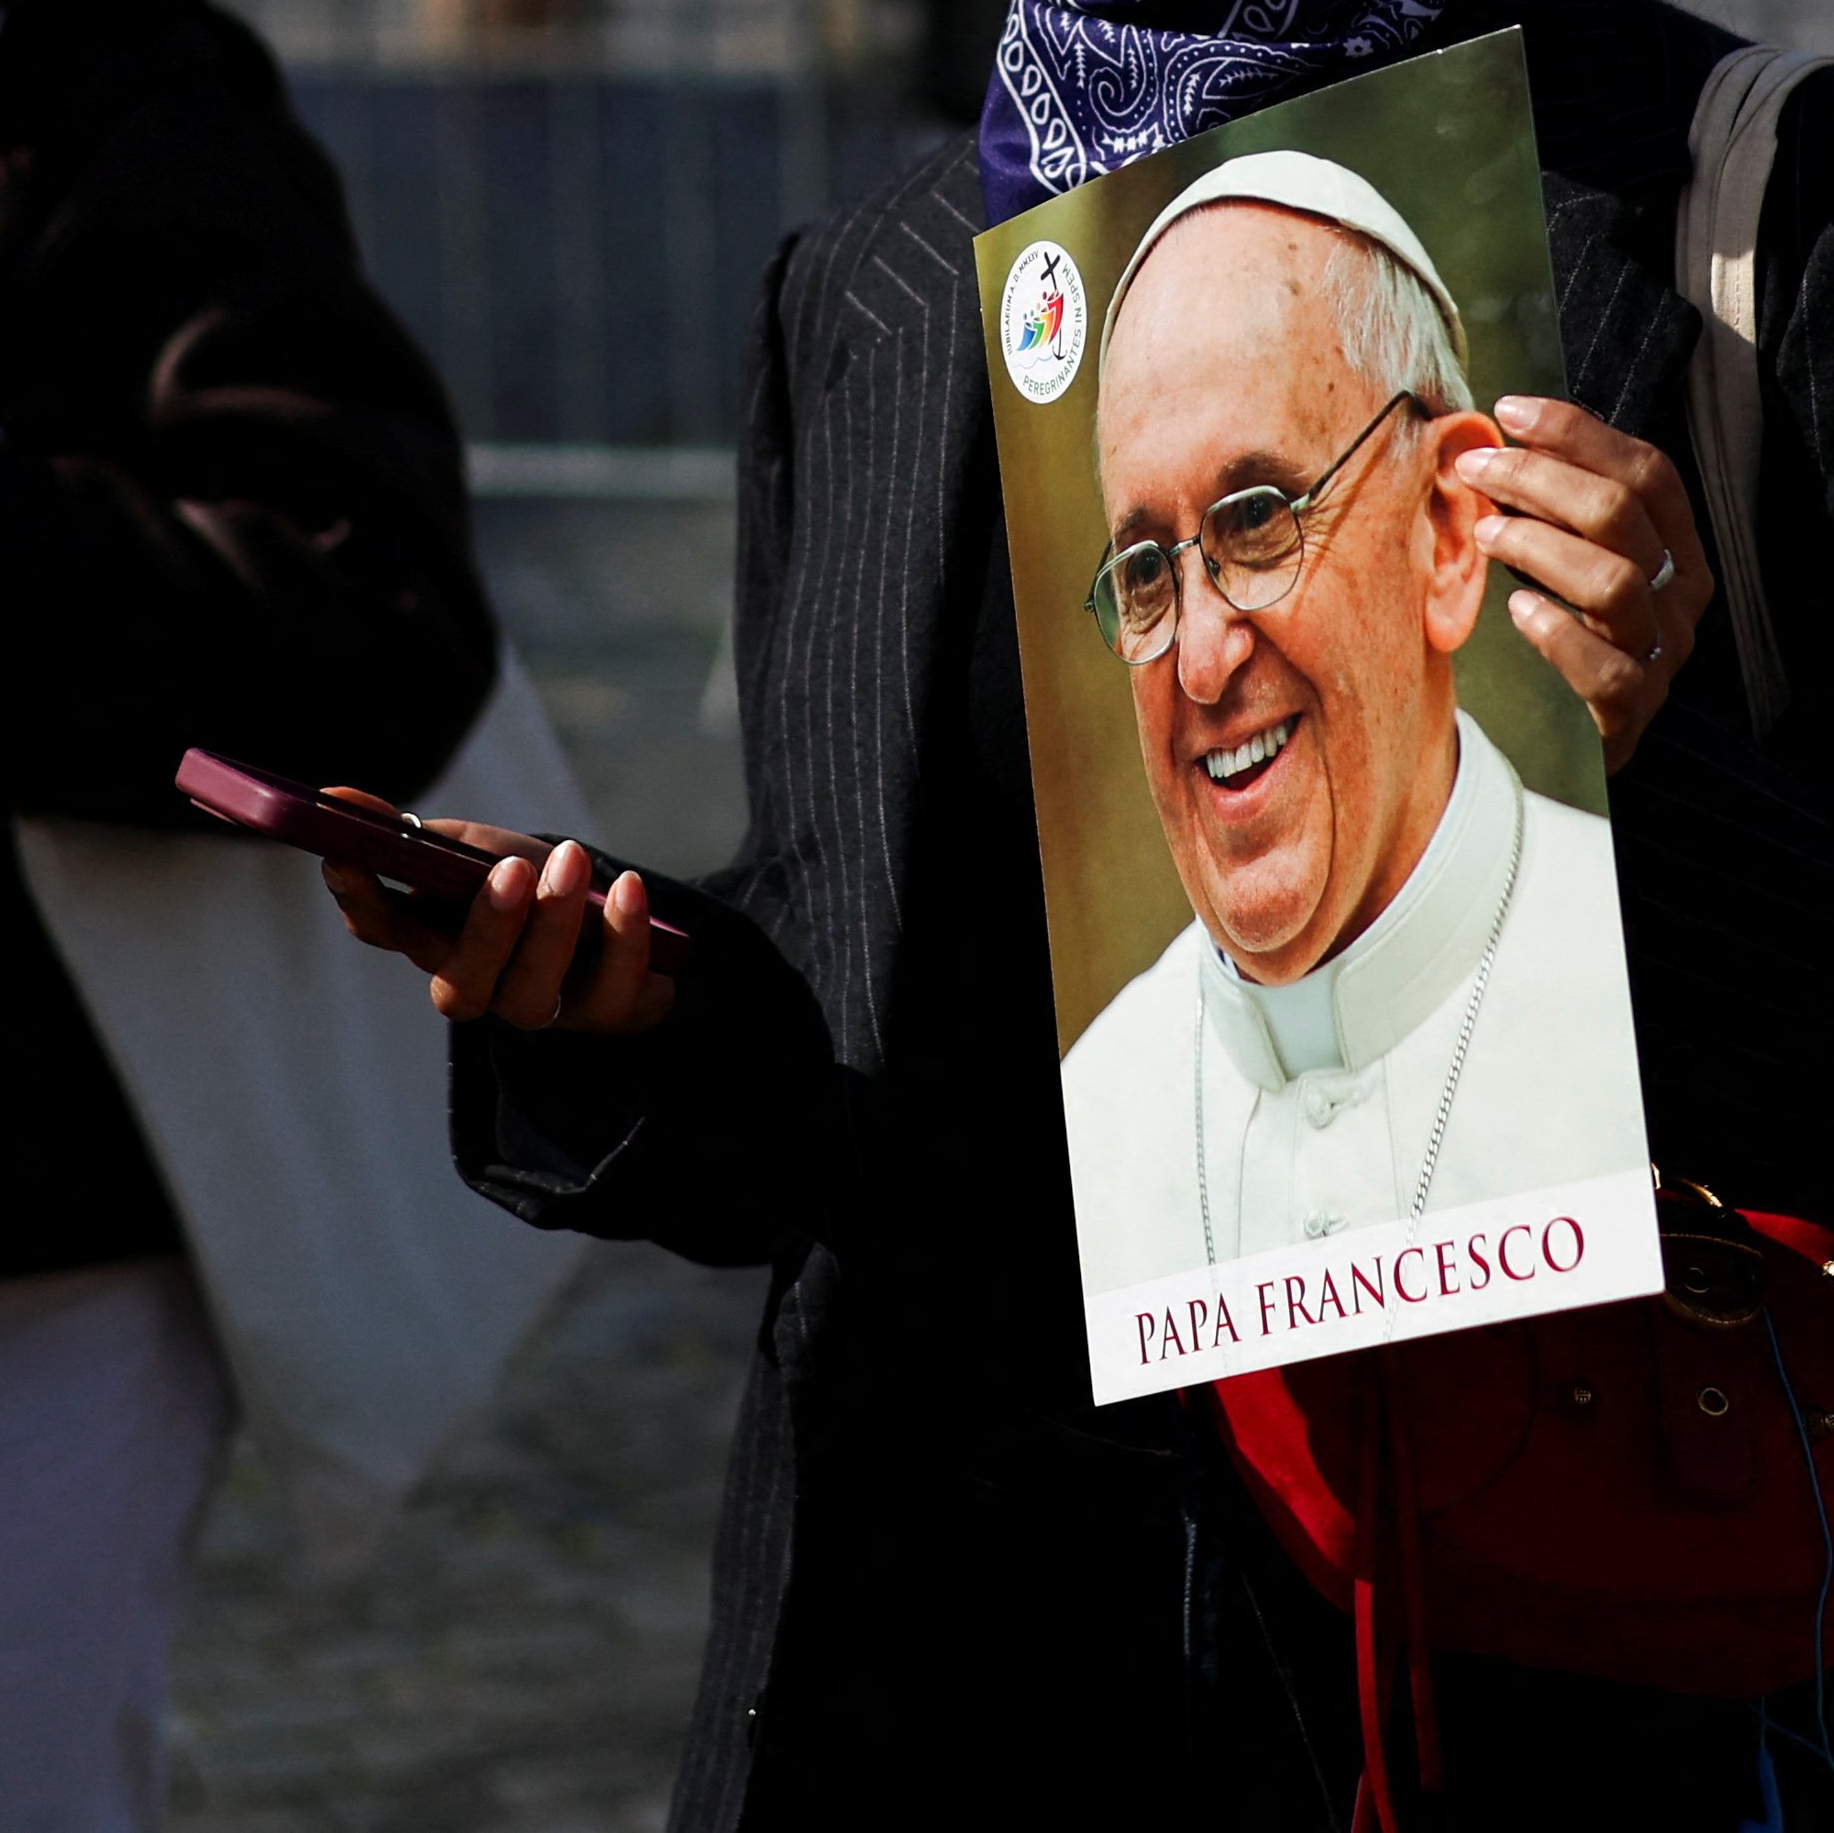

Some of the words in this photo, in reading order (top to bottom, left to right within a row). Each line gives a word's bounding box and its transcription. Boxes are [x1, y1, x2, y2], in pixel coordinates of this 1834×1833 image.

[1062, 263, 1081, 304] SPEM
[1004, 295, 1013, 355] IUBILAEUM
[1074, 307, 1083, 323] IN
[1023, 328, 1082, 396] PEREGRINANTES
[1135, 1292, 1242, 1366] PAPA
[1255, 1216, 1585, 1336] FRANCESCO
